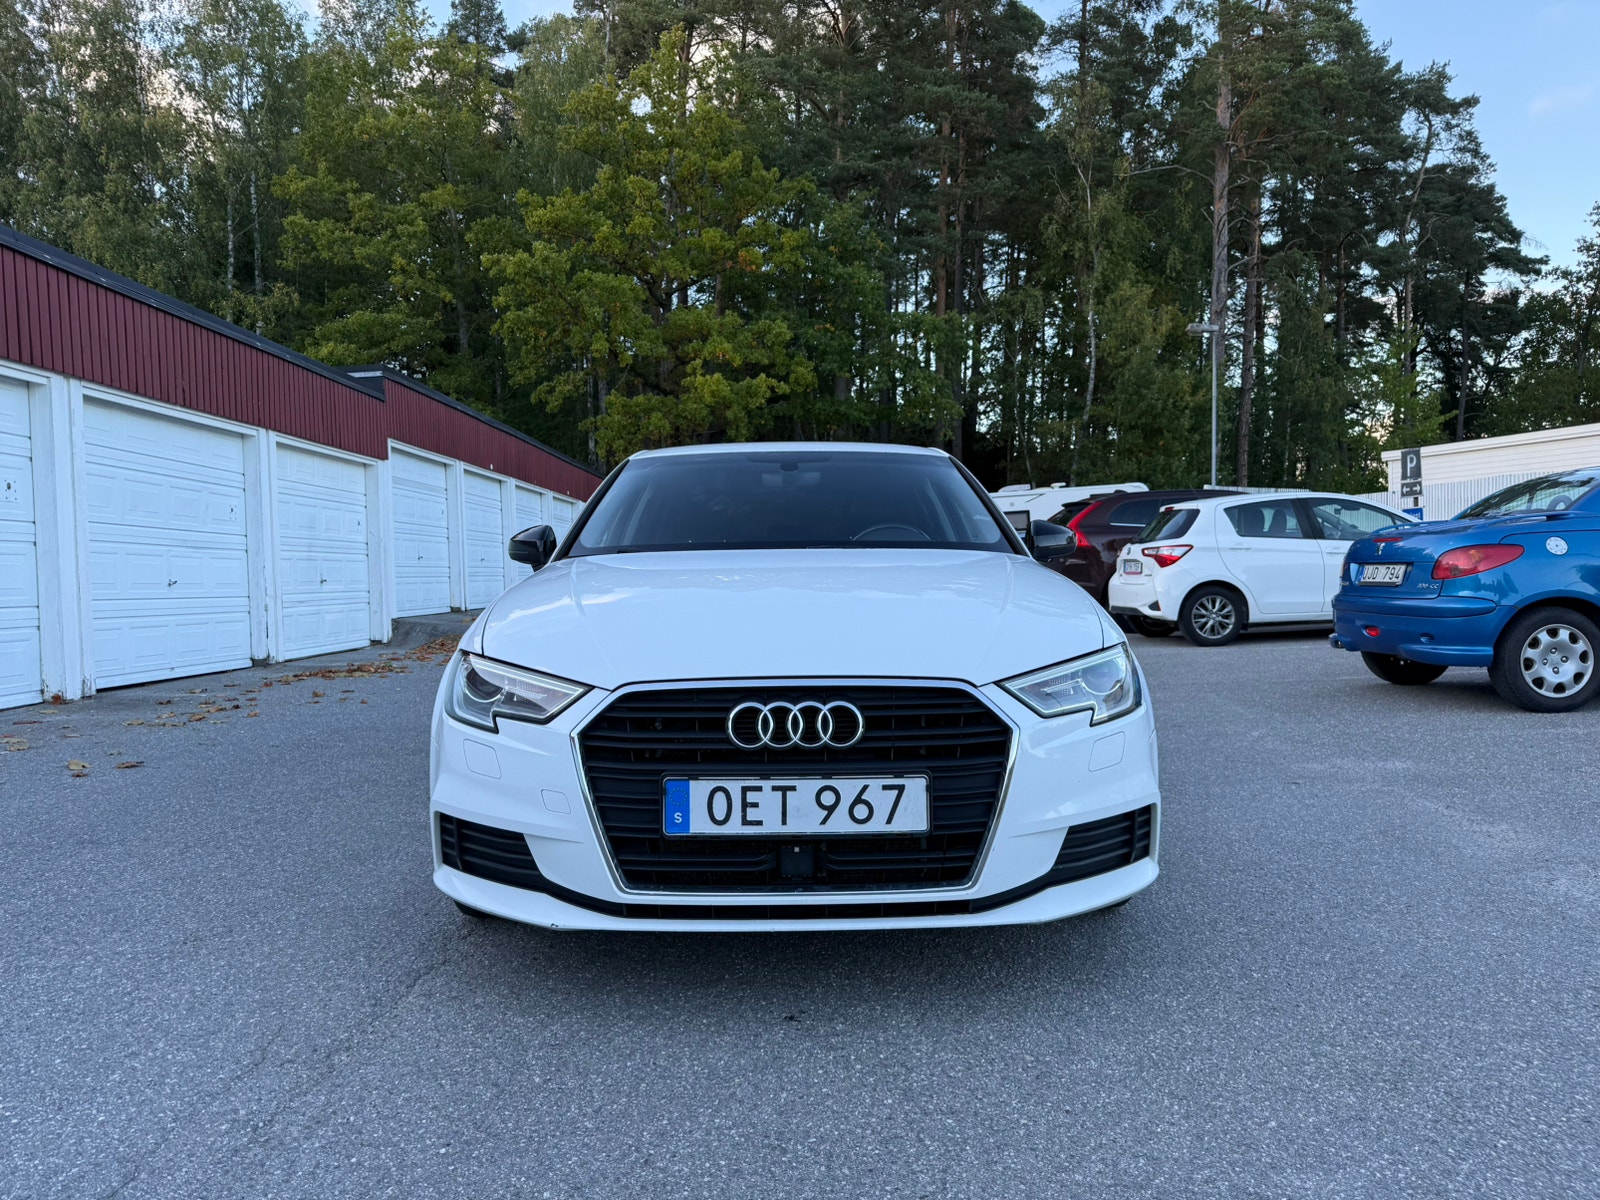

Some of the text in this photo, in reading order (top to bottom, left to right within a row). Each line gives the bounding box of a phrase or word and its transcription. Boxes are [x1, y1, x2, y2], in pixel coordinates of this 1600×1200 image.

[1407, 454, 1417, 477] P
[1383, 566, 1402, 580] 794
[706, 784, 906, 826] OET 967
[674, 812, 682, 824] S
